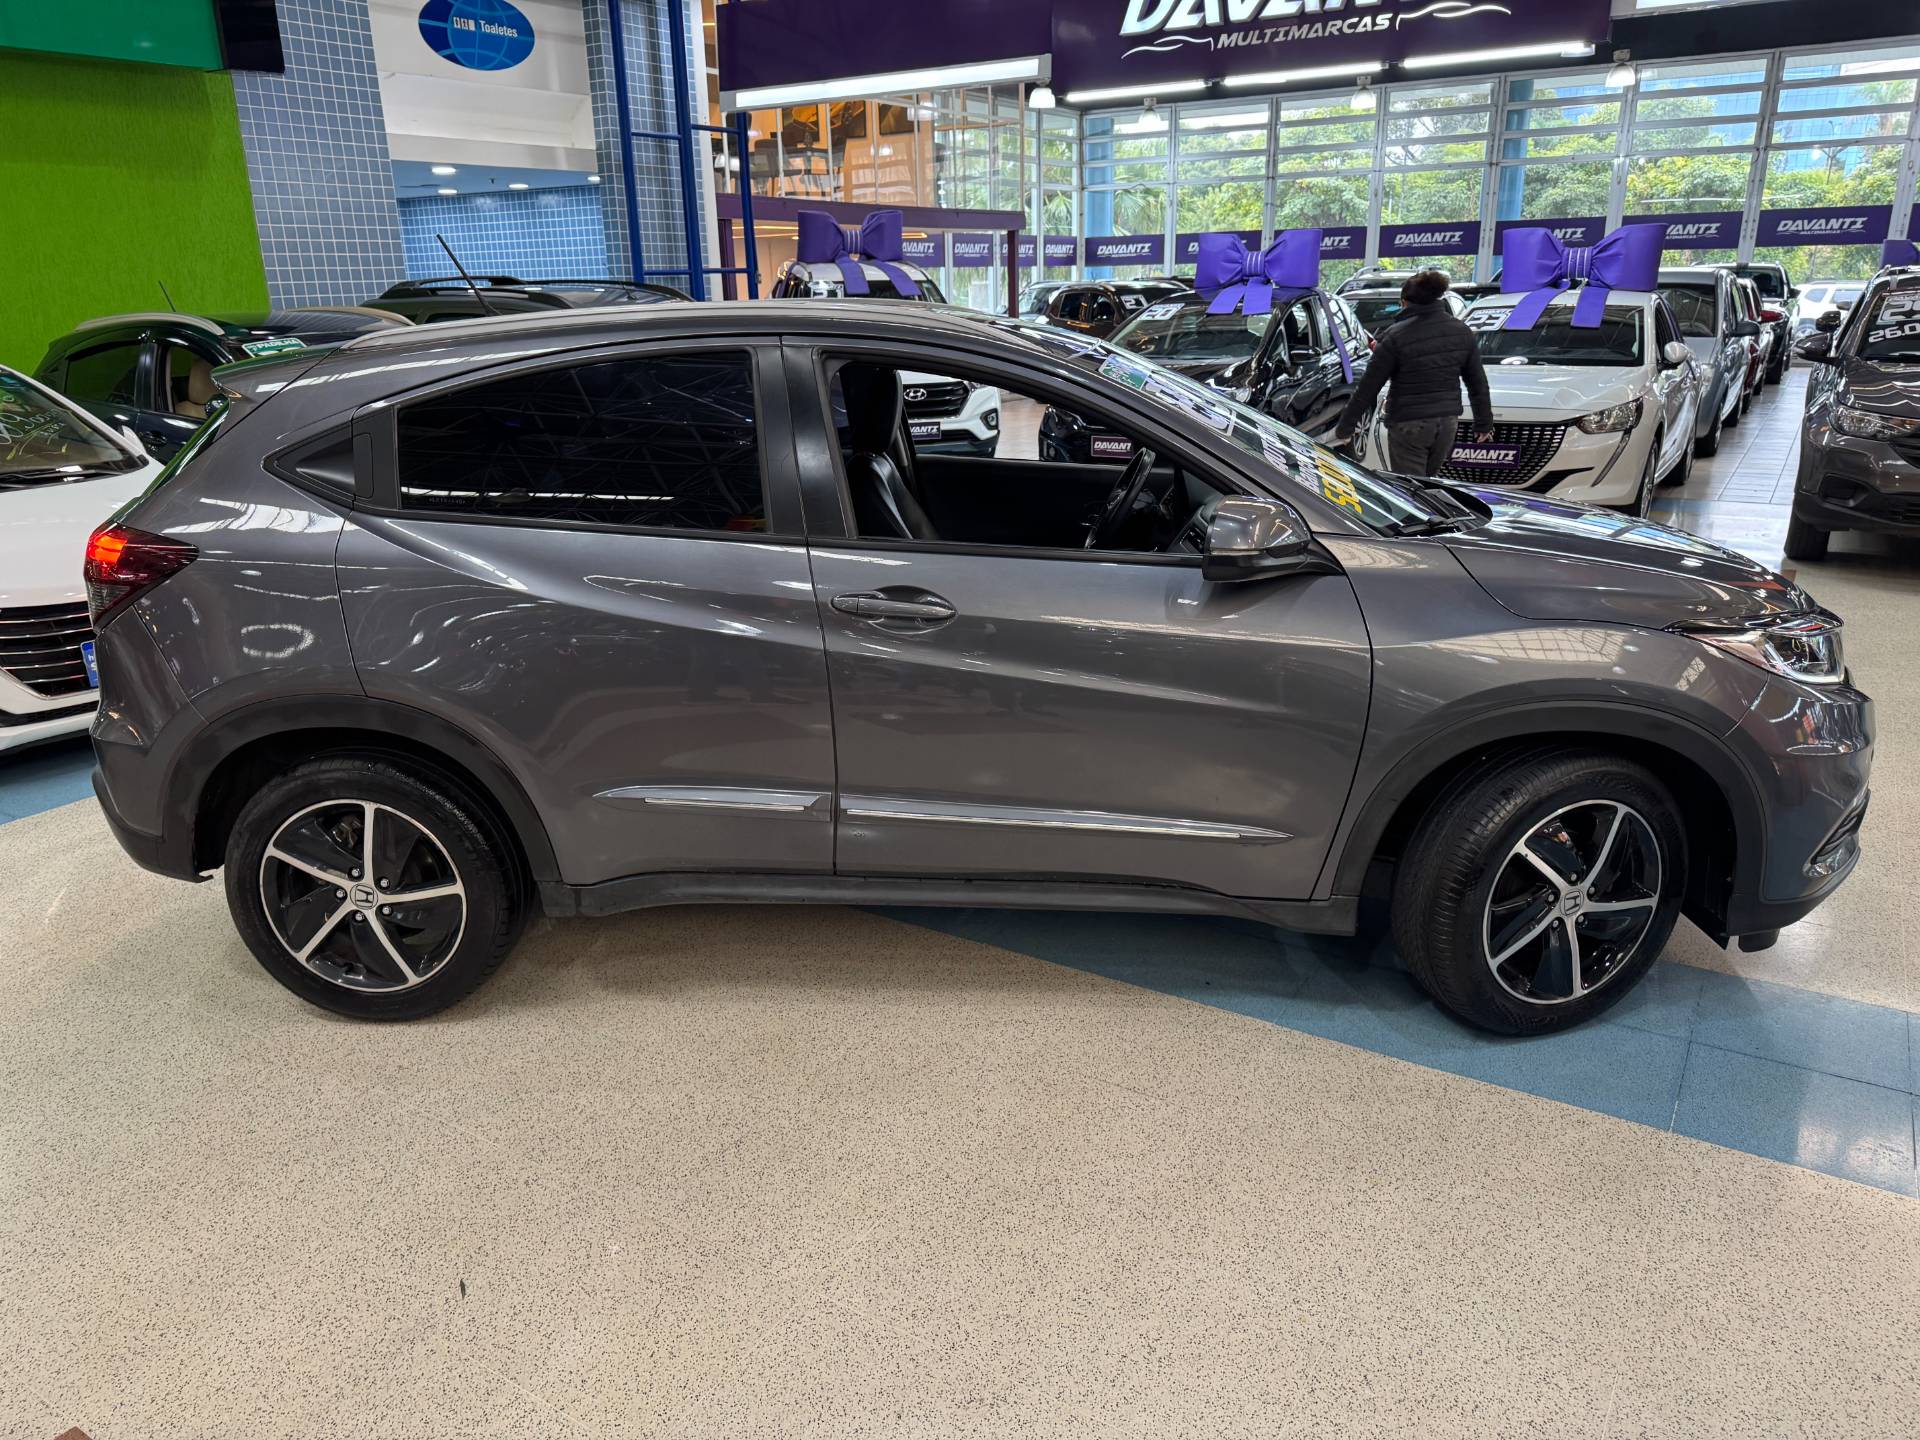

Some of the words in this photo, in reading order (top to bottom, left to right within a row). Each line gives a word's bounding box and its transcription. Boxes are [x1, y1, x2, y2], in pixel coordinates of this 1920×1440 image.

[479, 20, 518, 38] Toaletes
[1216, 13, 1394, 49] MULTIMARCAS
[1776, 217, 1868, 232] DAVANTI
[1394, 231, 1464, 244] DAVANTI
[902, 241, 934, 253] AVANTI
[954, 242, 989, 254] DAVANTI
[1045, 244, 1074, 254] DAVANTI
[1096, 243, 1152, 255] DAVANTI
[1094, 441, 1132, 451] DAVANT
[1451, 447, 1517, 461] DAVANTI
